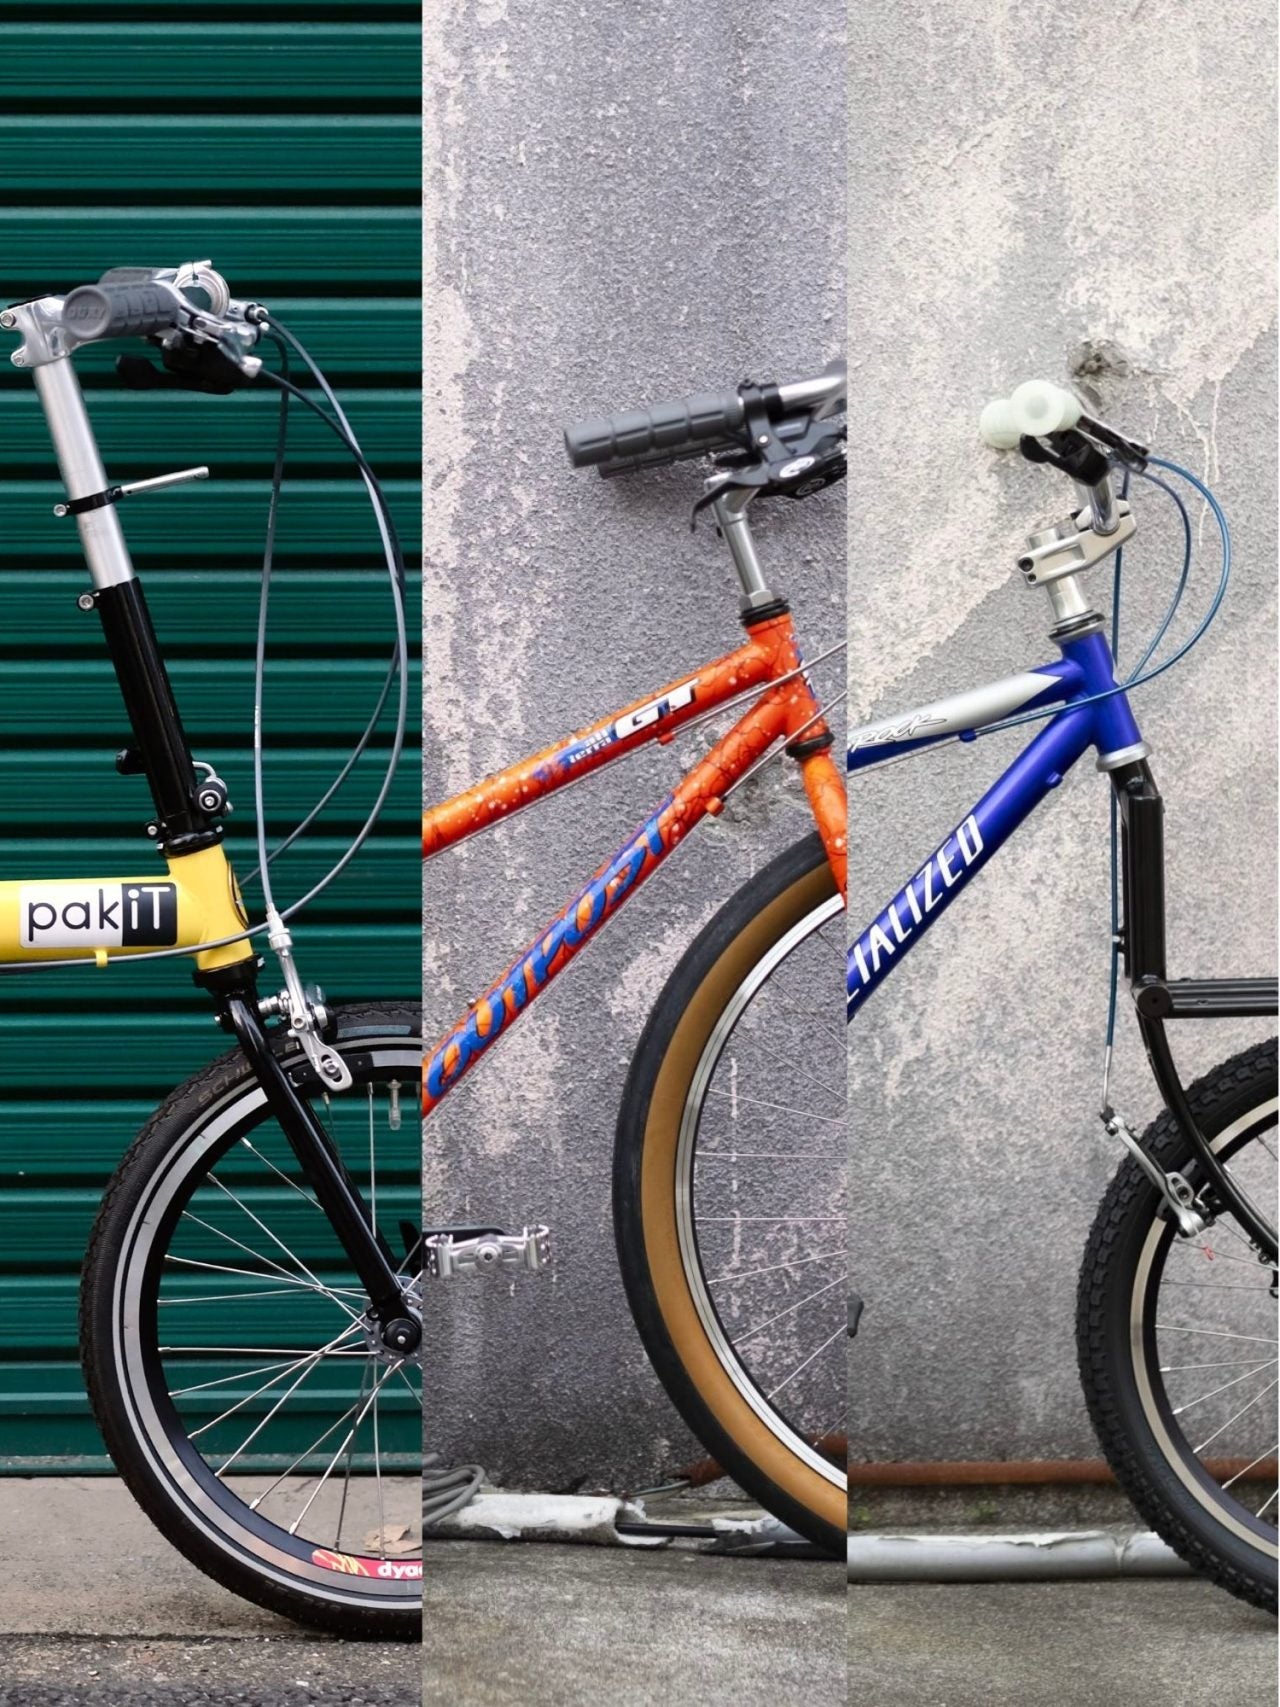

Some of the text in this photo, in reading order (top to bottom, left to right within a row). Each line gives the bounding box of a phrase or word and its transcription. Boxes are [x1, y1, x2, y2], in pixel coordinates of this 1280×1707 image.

[614, 677, 699, 740] GT
[28, 888, 171, 942] pakiT
[847, 814, 984, 1001] IALIZED
